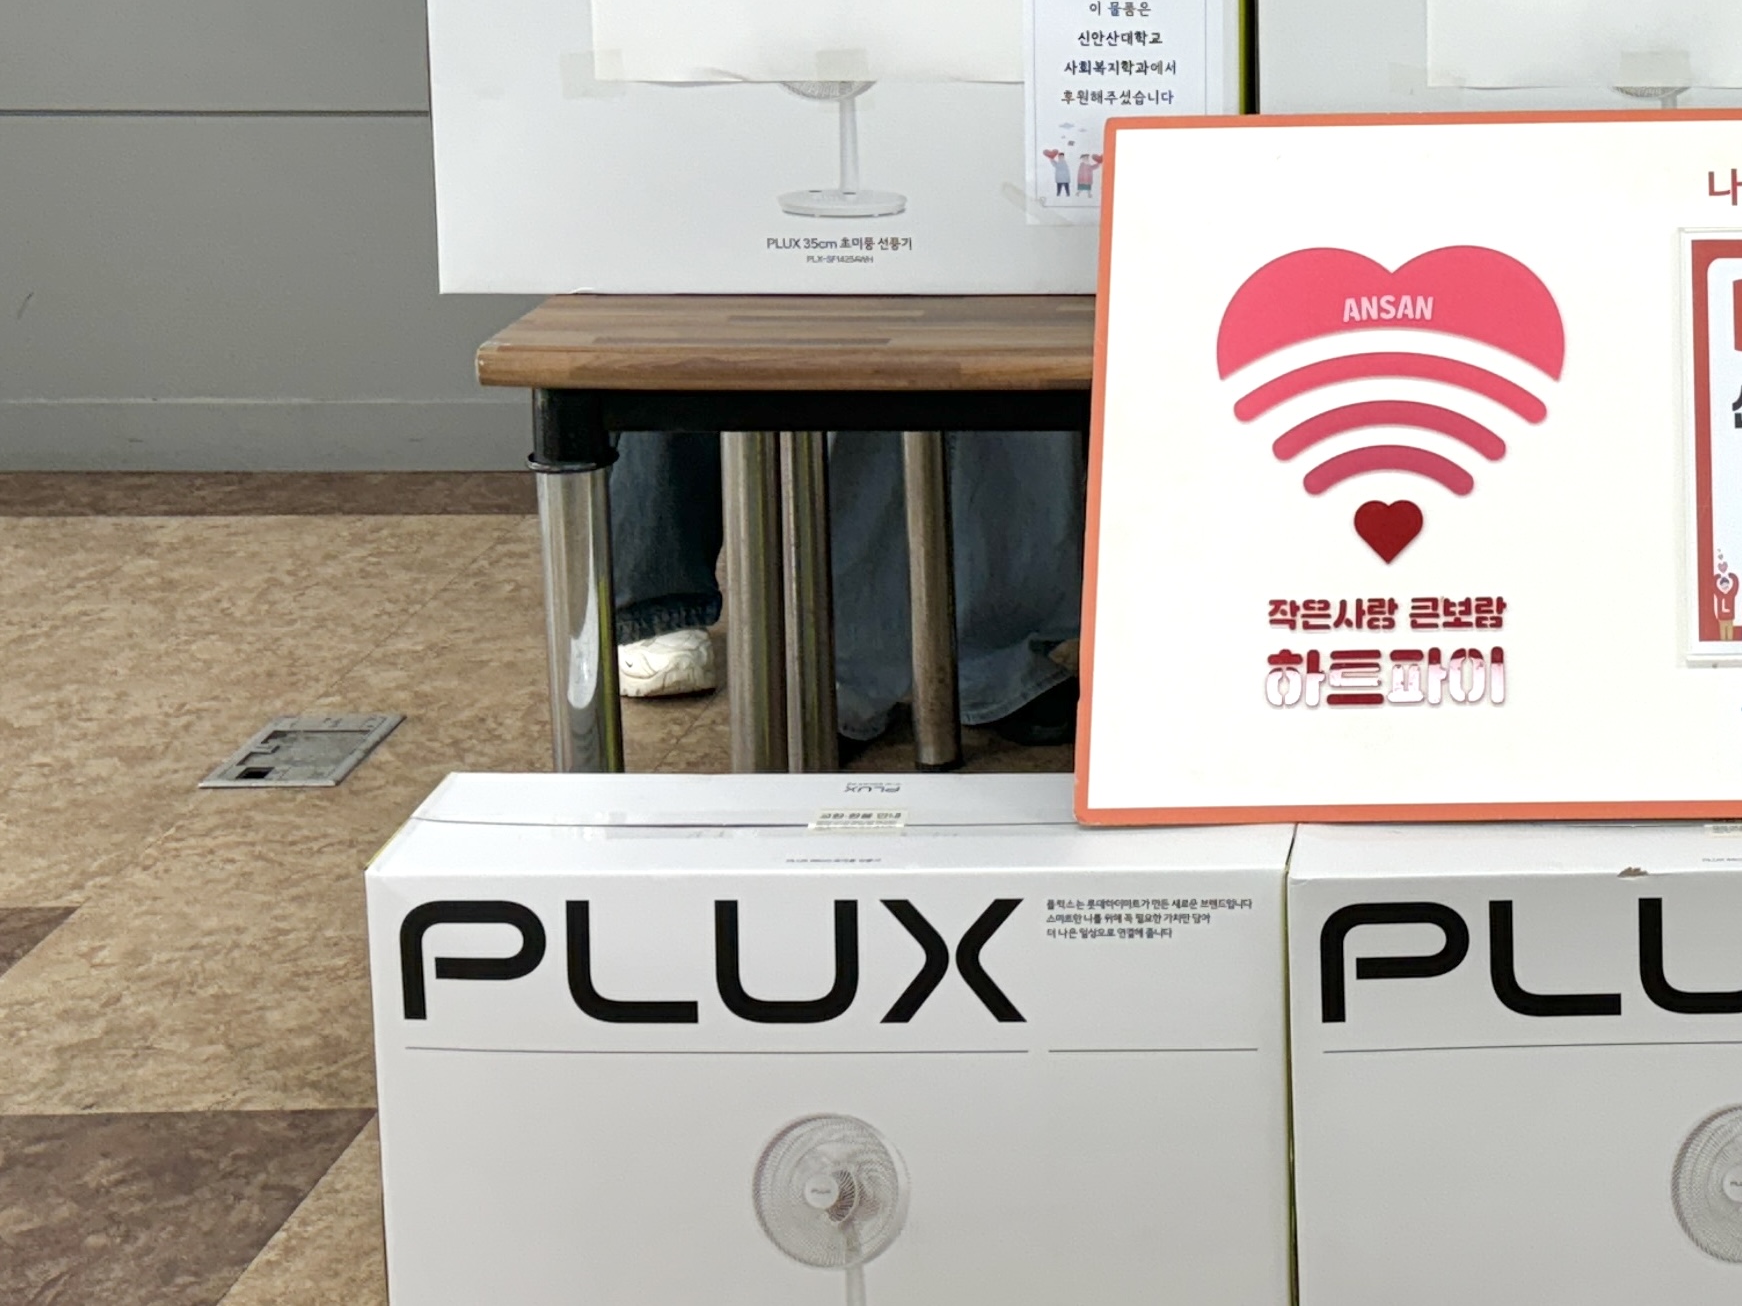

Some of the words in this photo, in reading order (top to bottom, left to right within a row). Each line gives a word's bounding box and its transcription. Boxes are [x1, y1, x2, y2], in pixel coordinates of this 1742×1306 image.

[1089, 1, 1101, 16] 이
[1108, 1, 1151, 16] 물품은
[1078, 30, 1163, 46] 신안산대학교
[1064, 60, 1176, 75] 사회복지학과에서
[766, 238, 800, 249] PLUX
[803, 238, 837, 249] 35cm
[878, 237, 912, 251] 선풍기
[1342, 294, 1434, 323] ANSAN
[1267, 597, 1400, 631] 작은사랑
[1408, 596, 1508, 630] 큰보람
[1265, 646, 1506, 707] 하트파이
[399, 898, 1027, 1024] PLUX
